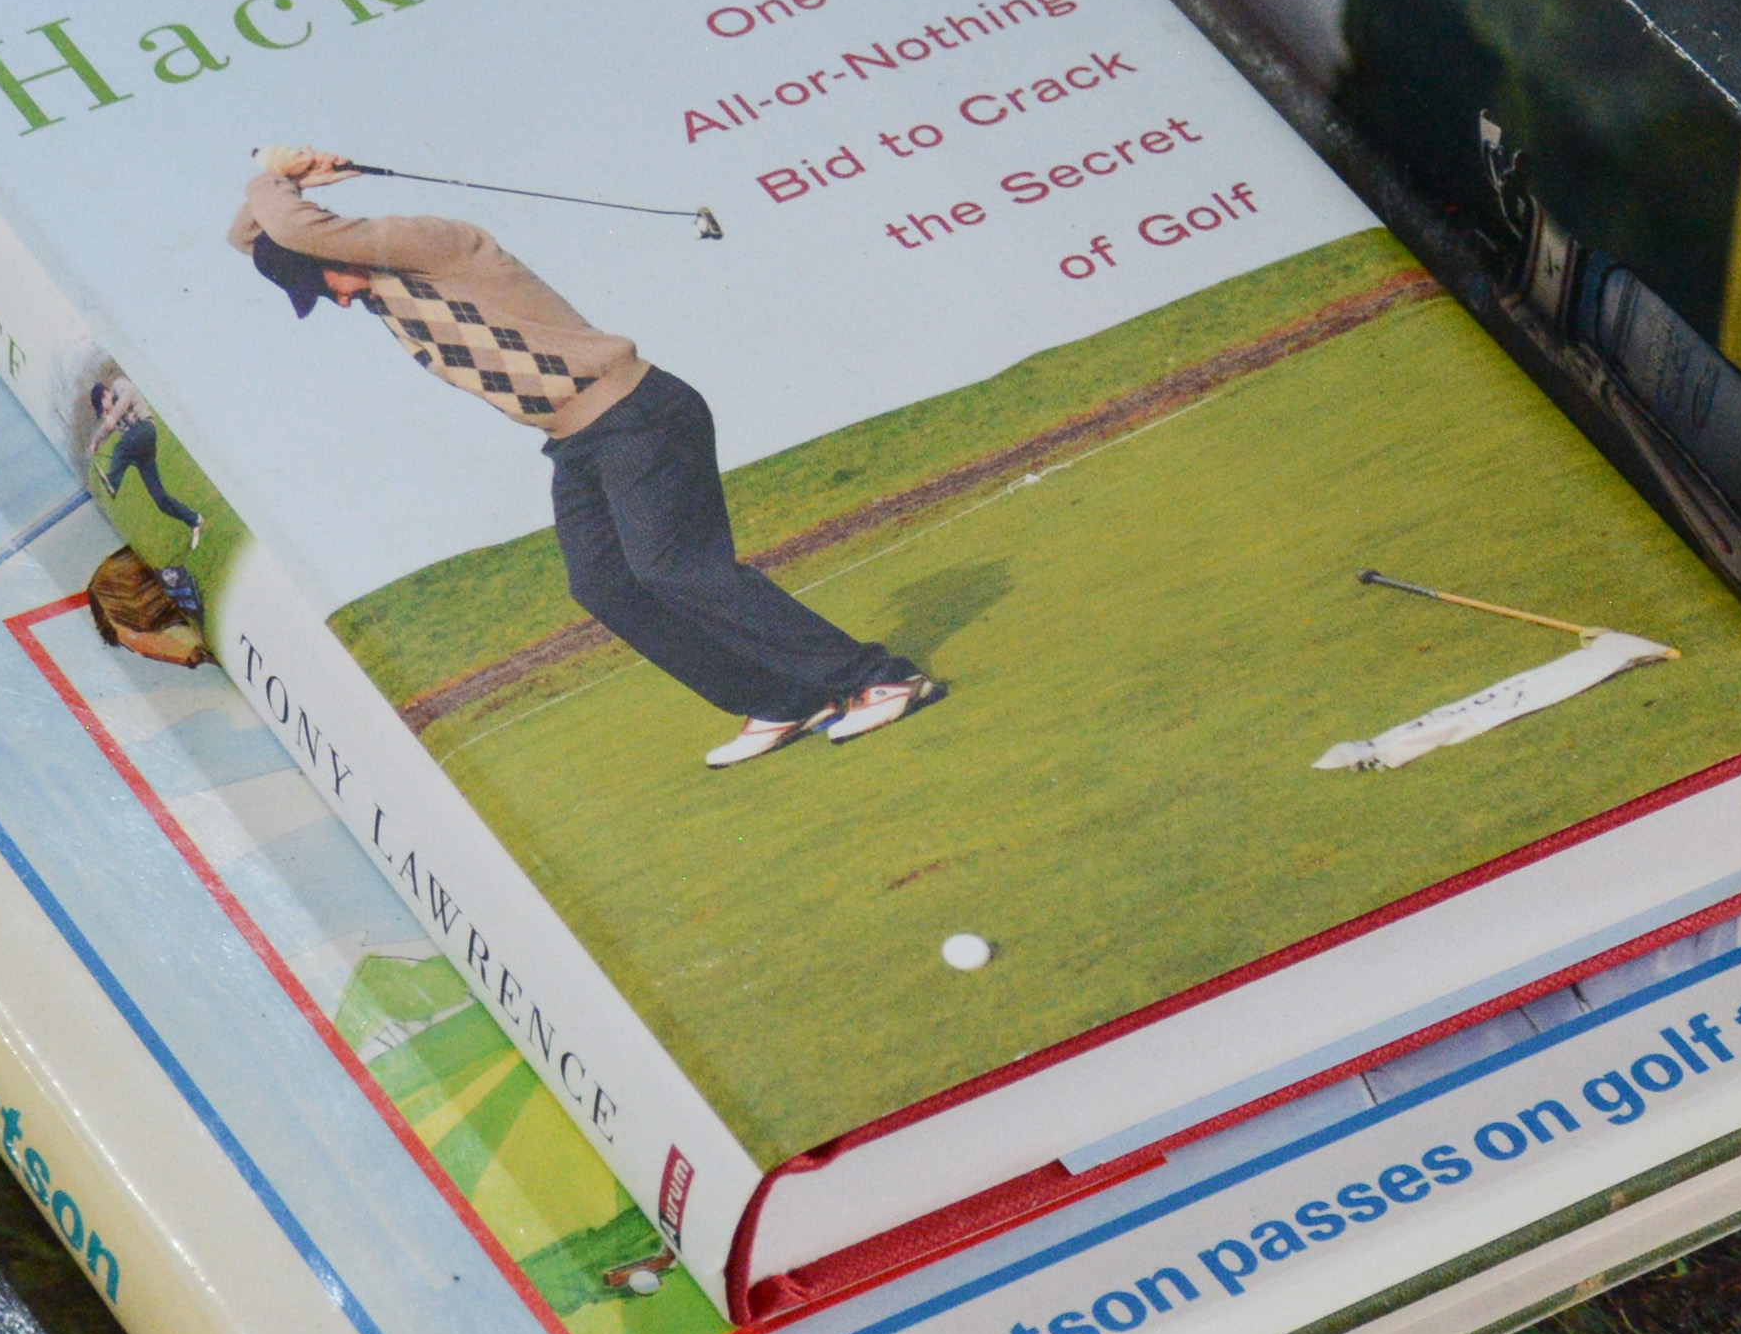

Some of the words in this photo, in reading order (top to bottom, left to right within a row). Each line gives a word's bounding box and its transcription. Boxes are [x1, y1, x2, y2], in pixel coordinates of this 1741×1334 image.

[756, 146, 868, 205] Bid
[878, 123, 944, 160] to
[958, 47, 1140, 128] Crack
[885, 198, 988, 252] the
[1000, 115, 1204, 206] Secret
[1060, 234, 1117, 281] of
[1137, 181, 1260, 249] Golf
[240, 634, 353, 803] TONY
[371, 801, 617, 1144] LAWRENCE
[1196, 1145, 1474, 1297] passes
[1473, 1096, 1581, 1162] on
[1581, 1012, 1736, 1126] golf
